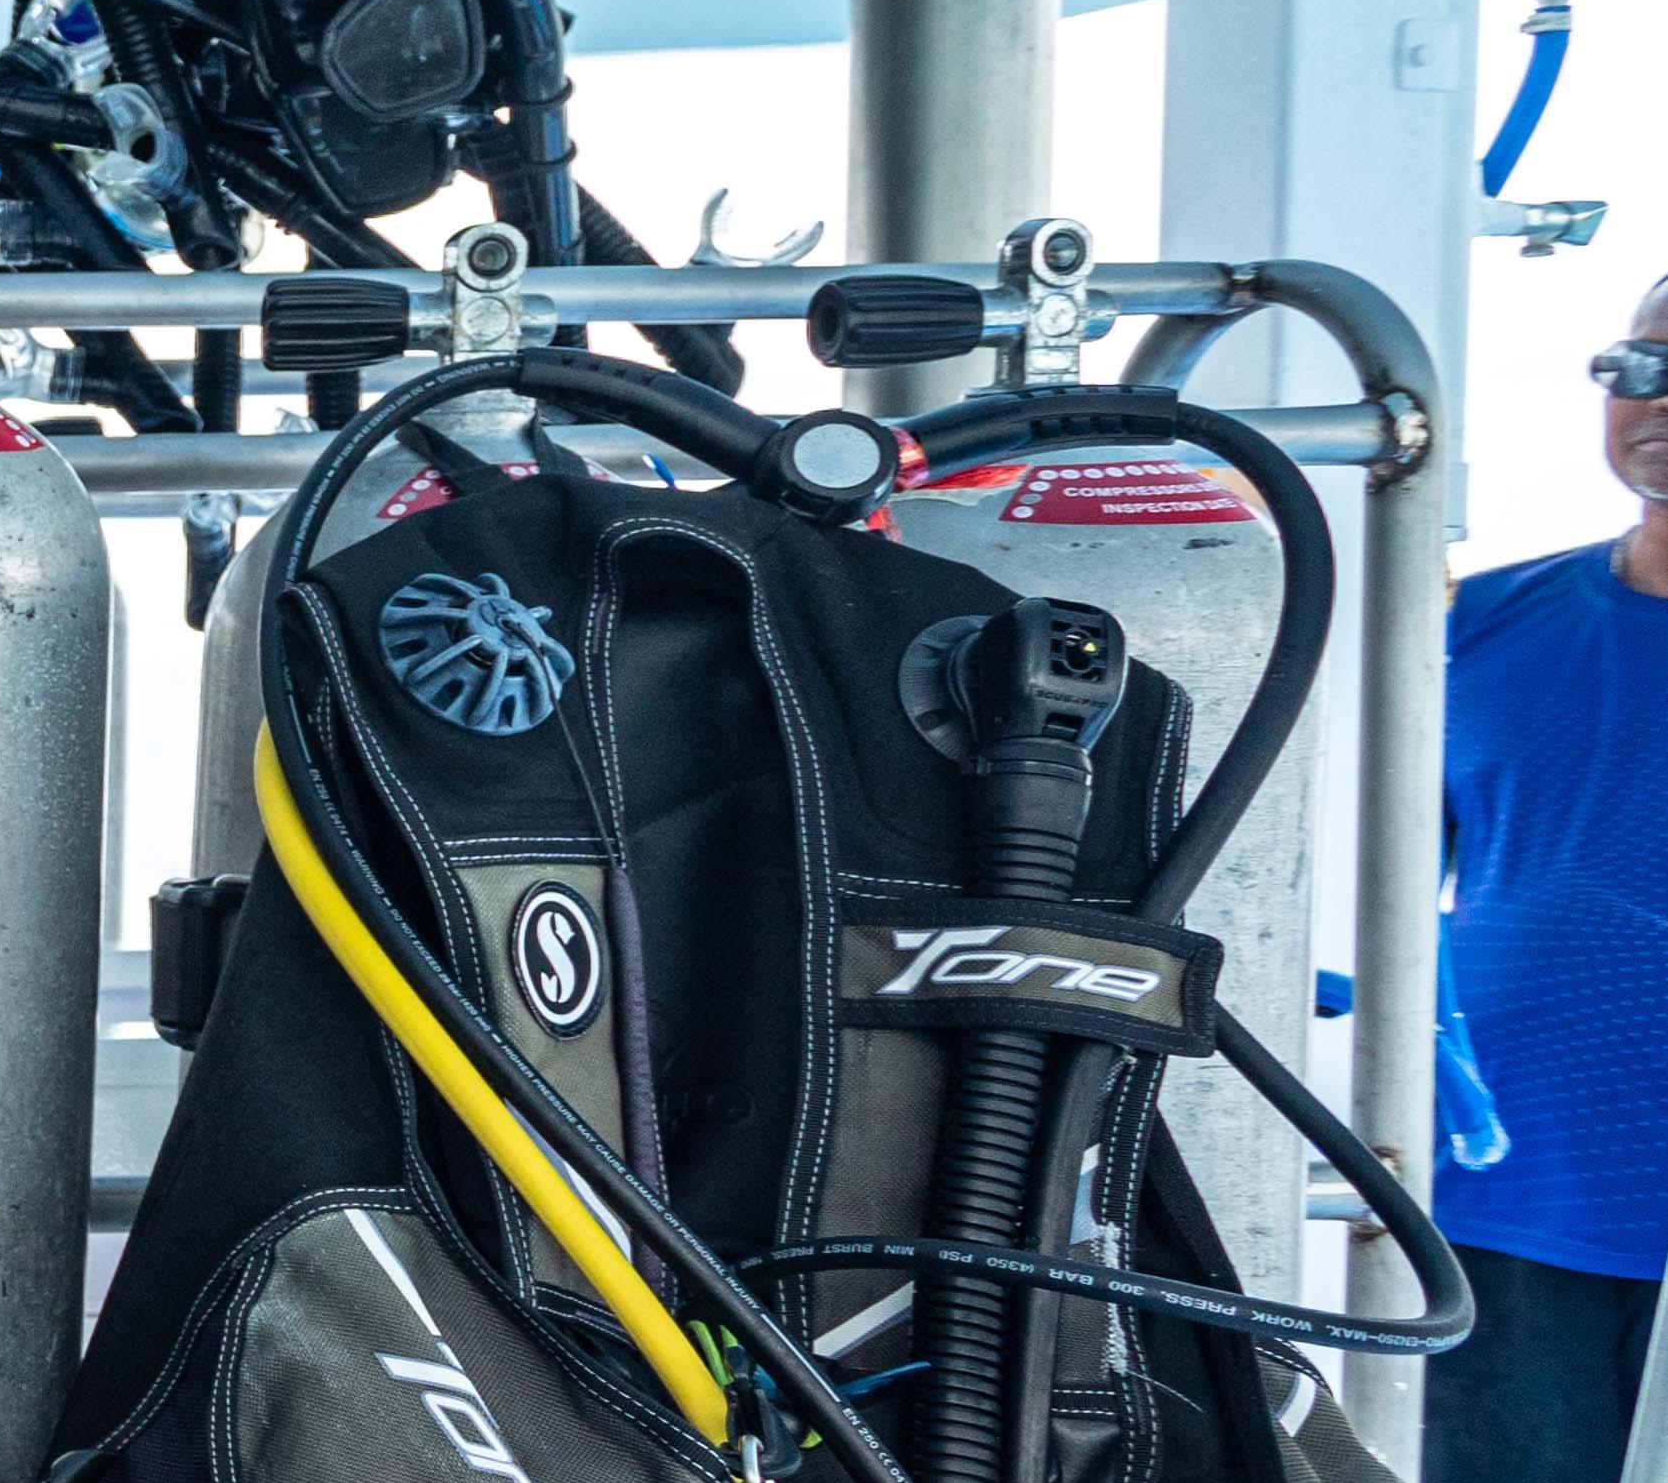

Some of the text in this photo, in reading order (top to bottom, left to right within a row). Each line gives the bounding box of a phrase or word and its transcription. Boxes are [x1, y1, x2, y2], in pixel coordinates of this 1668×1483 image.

[877, 925, 1161, 1002] Tone
[350, 849, 385, 897] WARNING
[390, 908, 401, 921] DO
[400, 921, 414, 939] NOT
[412, 938, 442, 974] EXCEED
[502, 1044, 534, 1080] HIGHER
[532, 1077, 578, 1125] PRESSURE
[575, 1123, 597, 1144] MAY
[594, 1143, 627, 1175] CAUSE
[624, 1173, 665, 1214] DAMAGE
[663, 1211, 680, 1229] OR
[677, 1226, 729, 1275] PERSONAL
[725, 1273, 761, 1310] INJURY
[822, 1242, 873, 1255] BURST
[883, 1243, 915, 1256] MIN
[1047, 1267, 1094, 1287] BAR
[1108, 1280, 1145, 1297] 300
[1160, 1289, 1237, 1316] PRESS.
[1251, 1309, 1313, 1333] WORK
[842, 1407, 860, 1427] EN
[857, 1427, 879, 1450] 250
